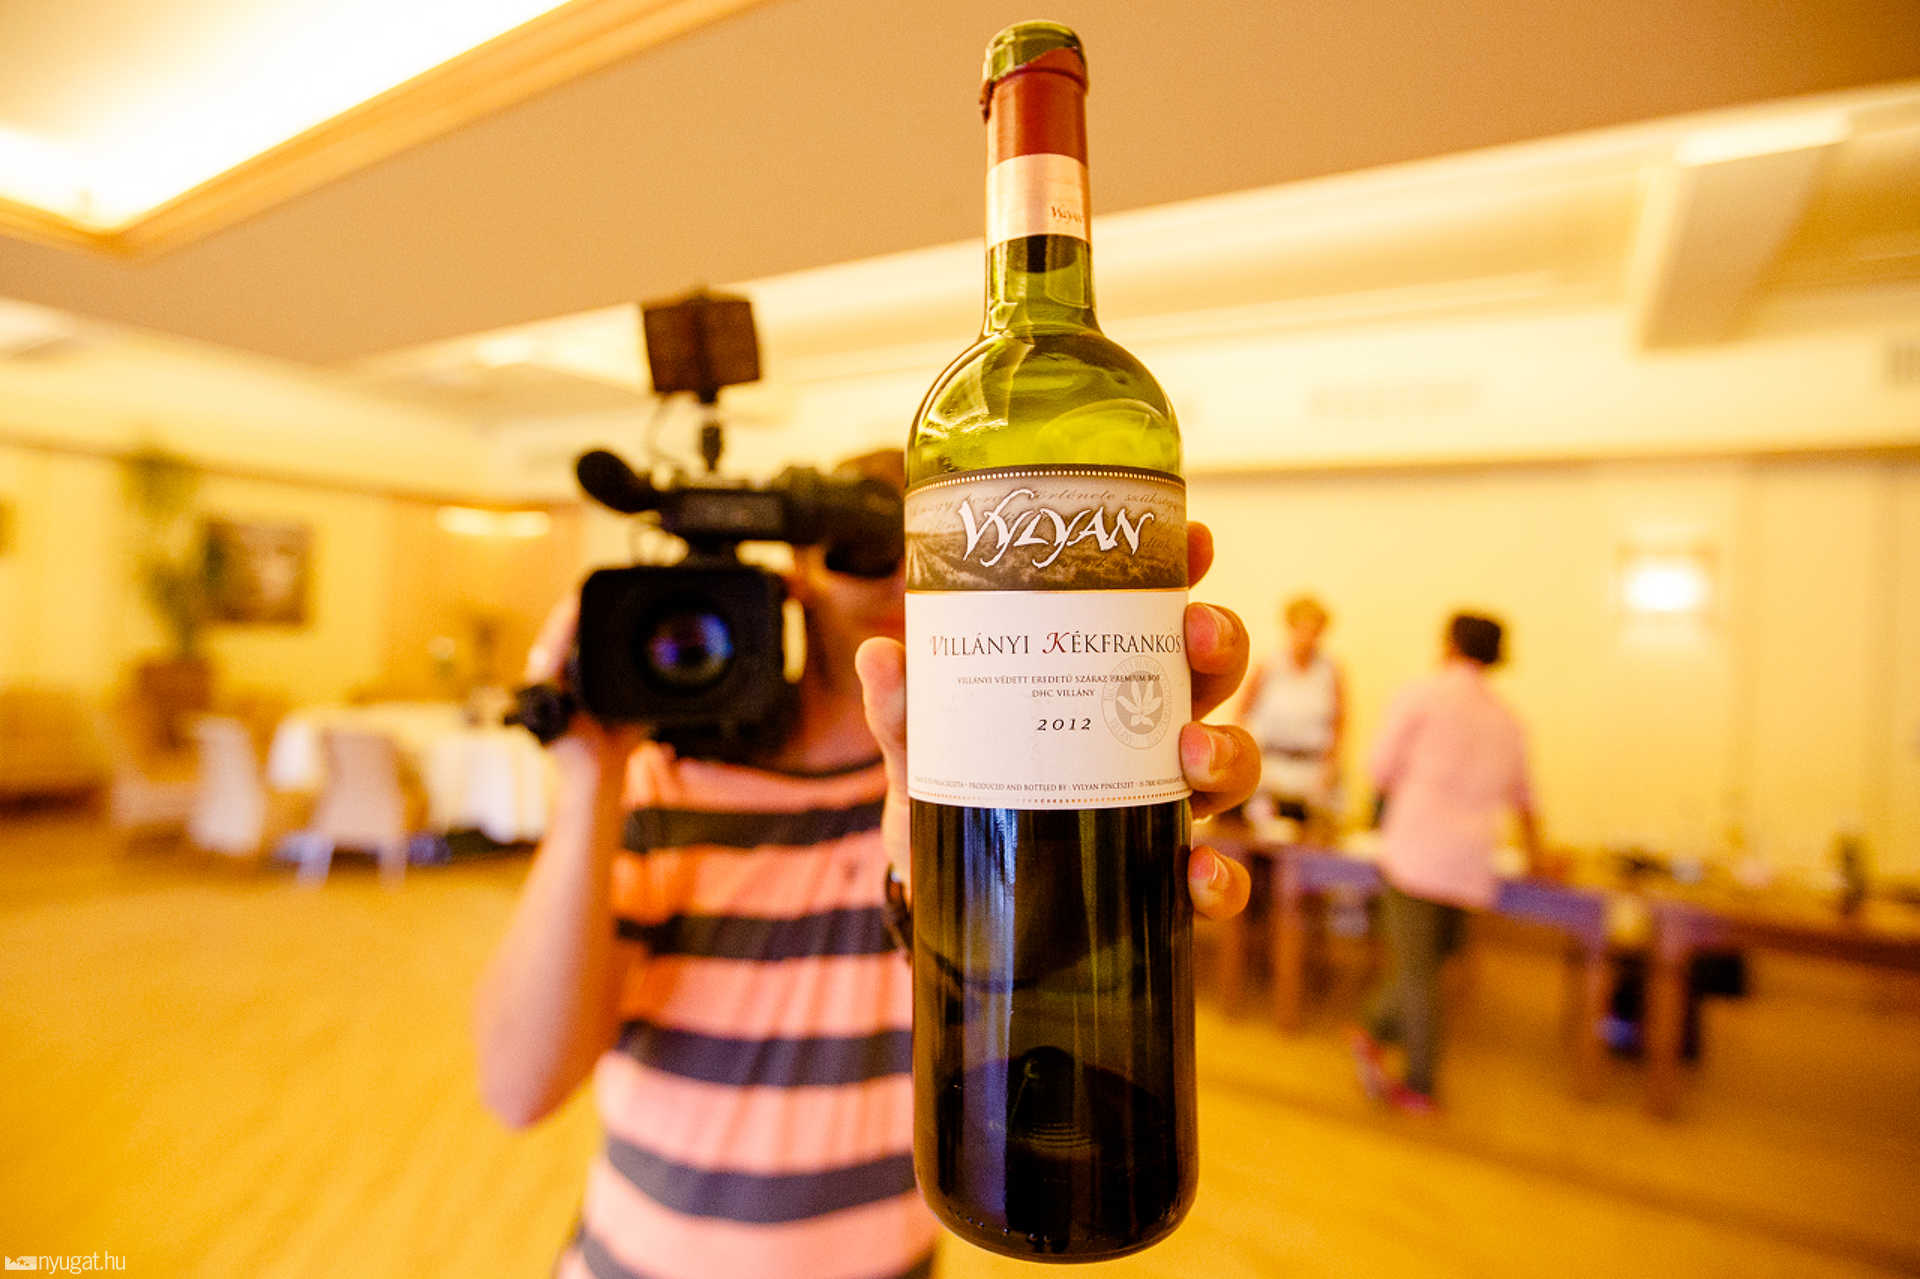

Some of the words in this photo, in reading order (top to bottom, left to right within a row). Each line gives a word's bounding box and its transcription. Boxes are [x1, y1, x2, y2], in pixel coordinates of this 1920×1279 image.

[958, 488, 1155, 569] VYLYAN
[930, 632, 1029, 656] VILLÁNYI
[994, 674, 1028, 685] VÉDETT
[1031, 688, 1055, 698] DHC
[1036, 717, 1092, 732] 2012
[968, 782, 1004, 792] PRODUCED
[1006, 783, 1023, 792] AND
[1023, 783, 1057, 792] BOTTLED
[1058, 783, 1067, 792] BY
